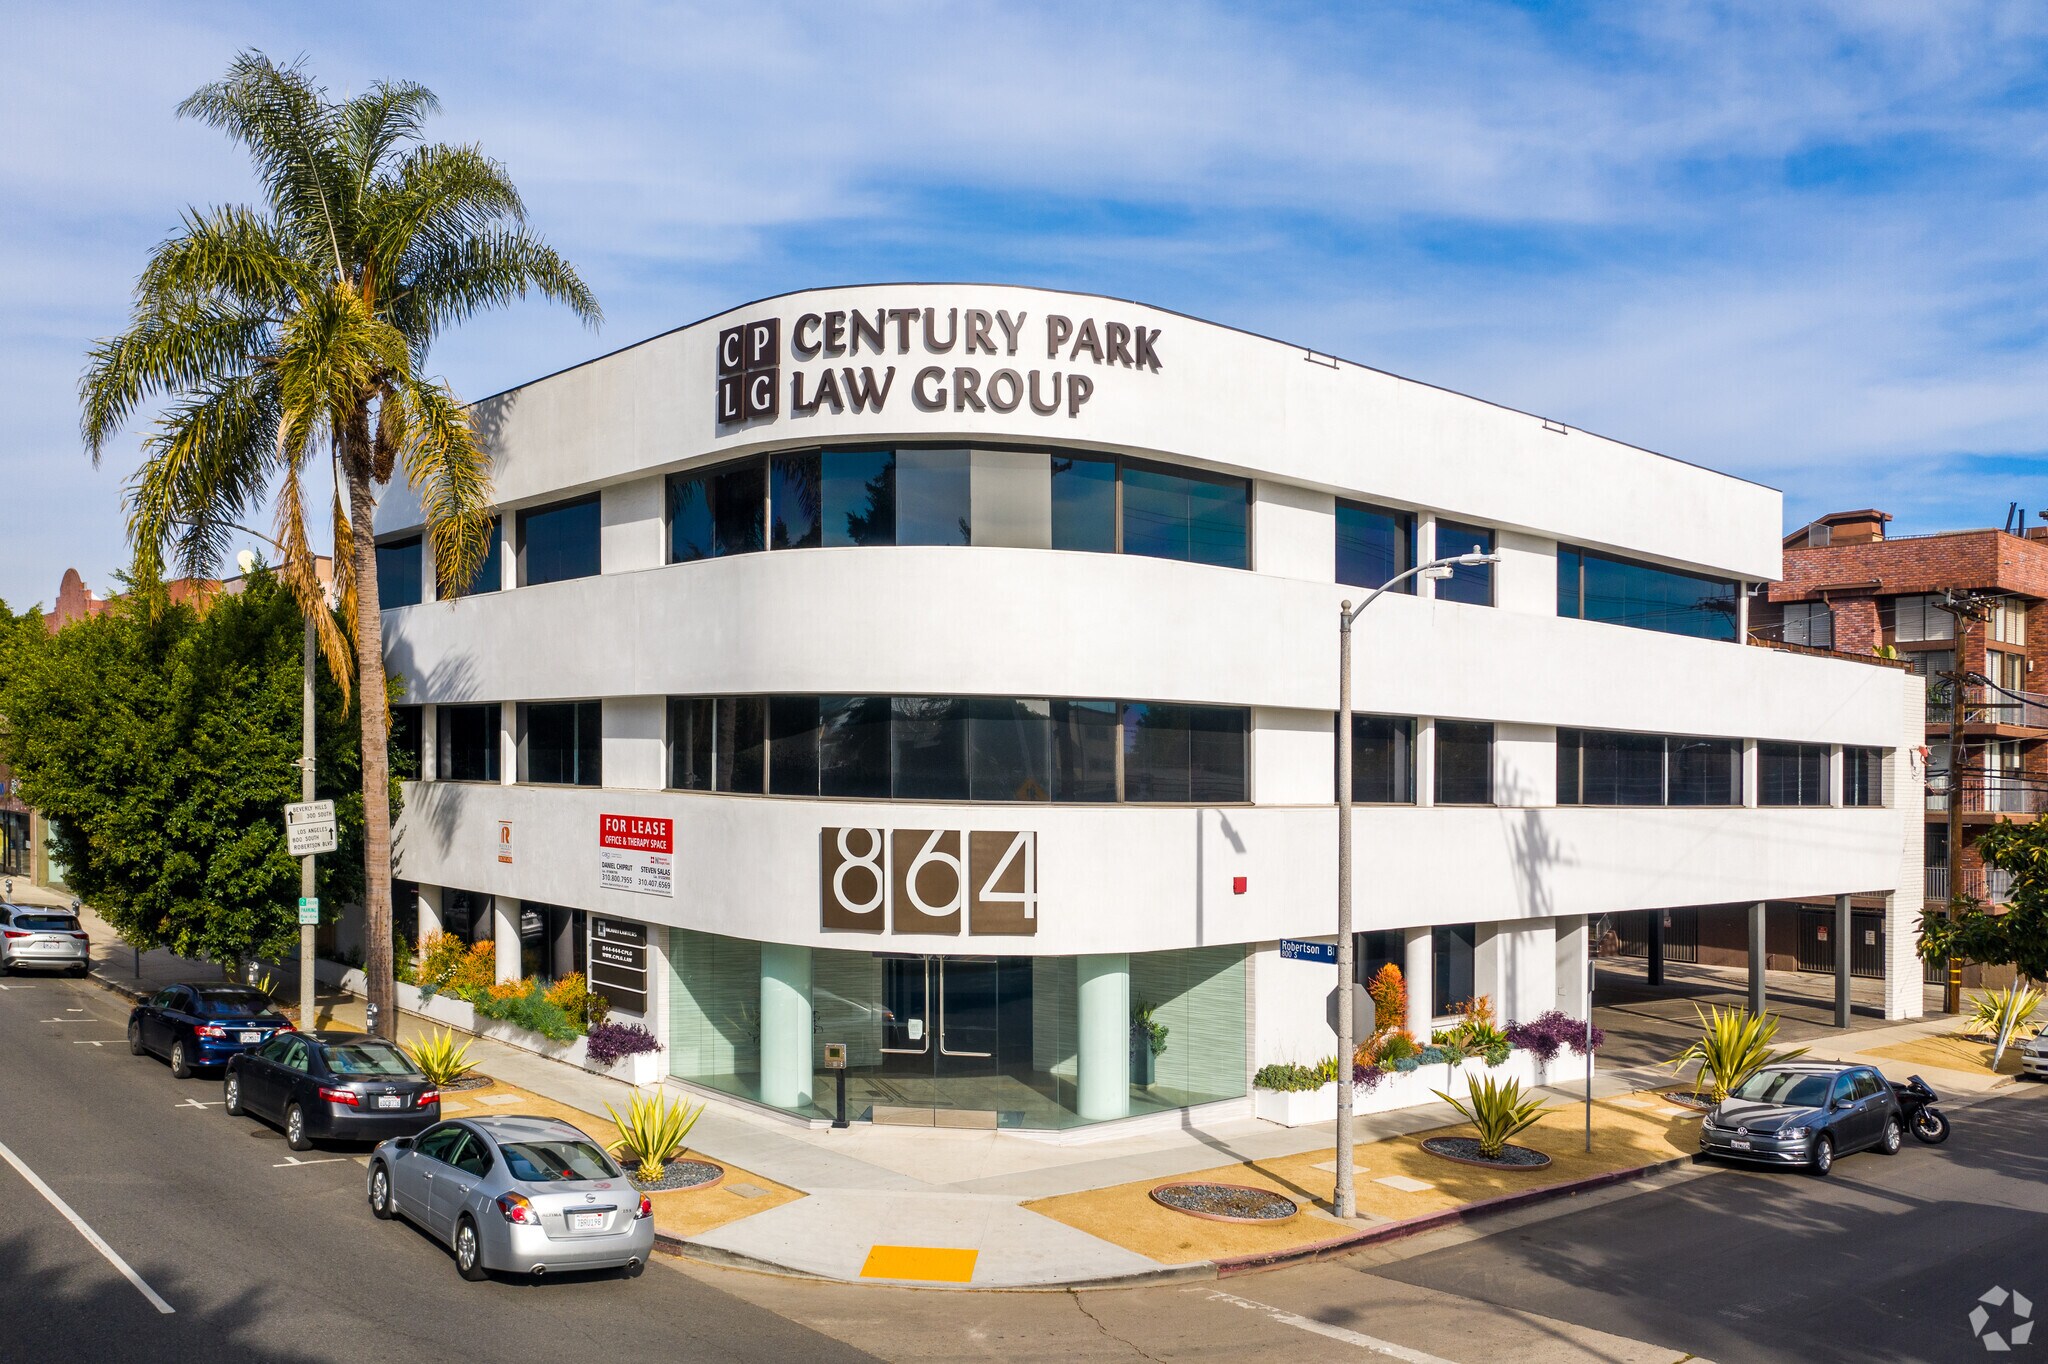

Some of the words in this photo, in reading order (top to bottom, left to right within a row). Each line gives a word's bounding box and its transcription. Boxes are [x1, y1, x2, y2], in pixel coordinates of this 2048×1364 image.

[794, 307, 1027, 355] CENTURY
[1048, 314, 1163, 369] PARK
[793, 366, 896, 413] LAW
[916, 367, 1094, 415] GROUP
[606, 818, 626, 832] FOR
[631, 820, 666, 836] LEASE
[293, 842, 320, 850] ROBERTSON
[605, 835, 622, 845] OFFICE
[622, 837, 627, 845] &
[627, 837, 650, 848] THERAPY
[650, 839, 667, 849] SPACE
[601, 861, 616, 870] DANIEL
[640, 866, 657, 875] STEVEN
[657, 868, 671, 876] SALAS
[833, 827, 1038, 919] 864
[1281, 950, 1293, 958] 800
[1294, 951, 1298, 959] S
[1282, 940, 1320, 955] Robertson
